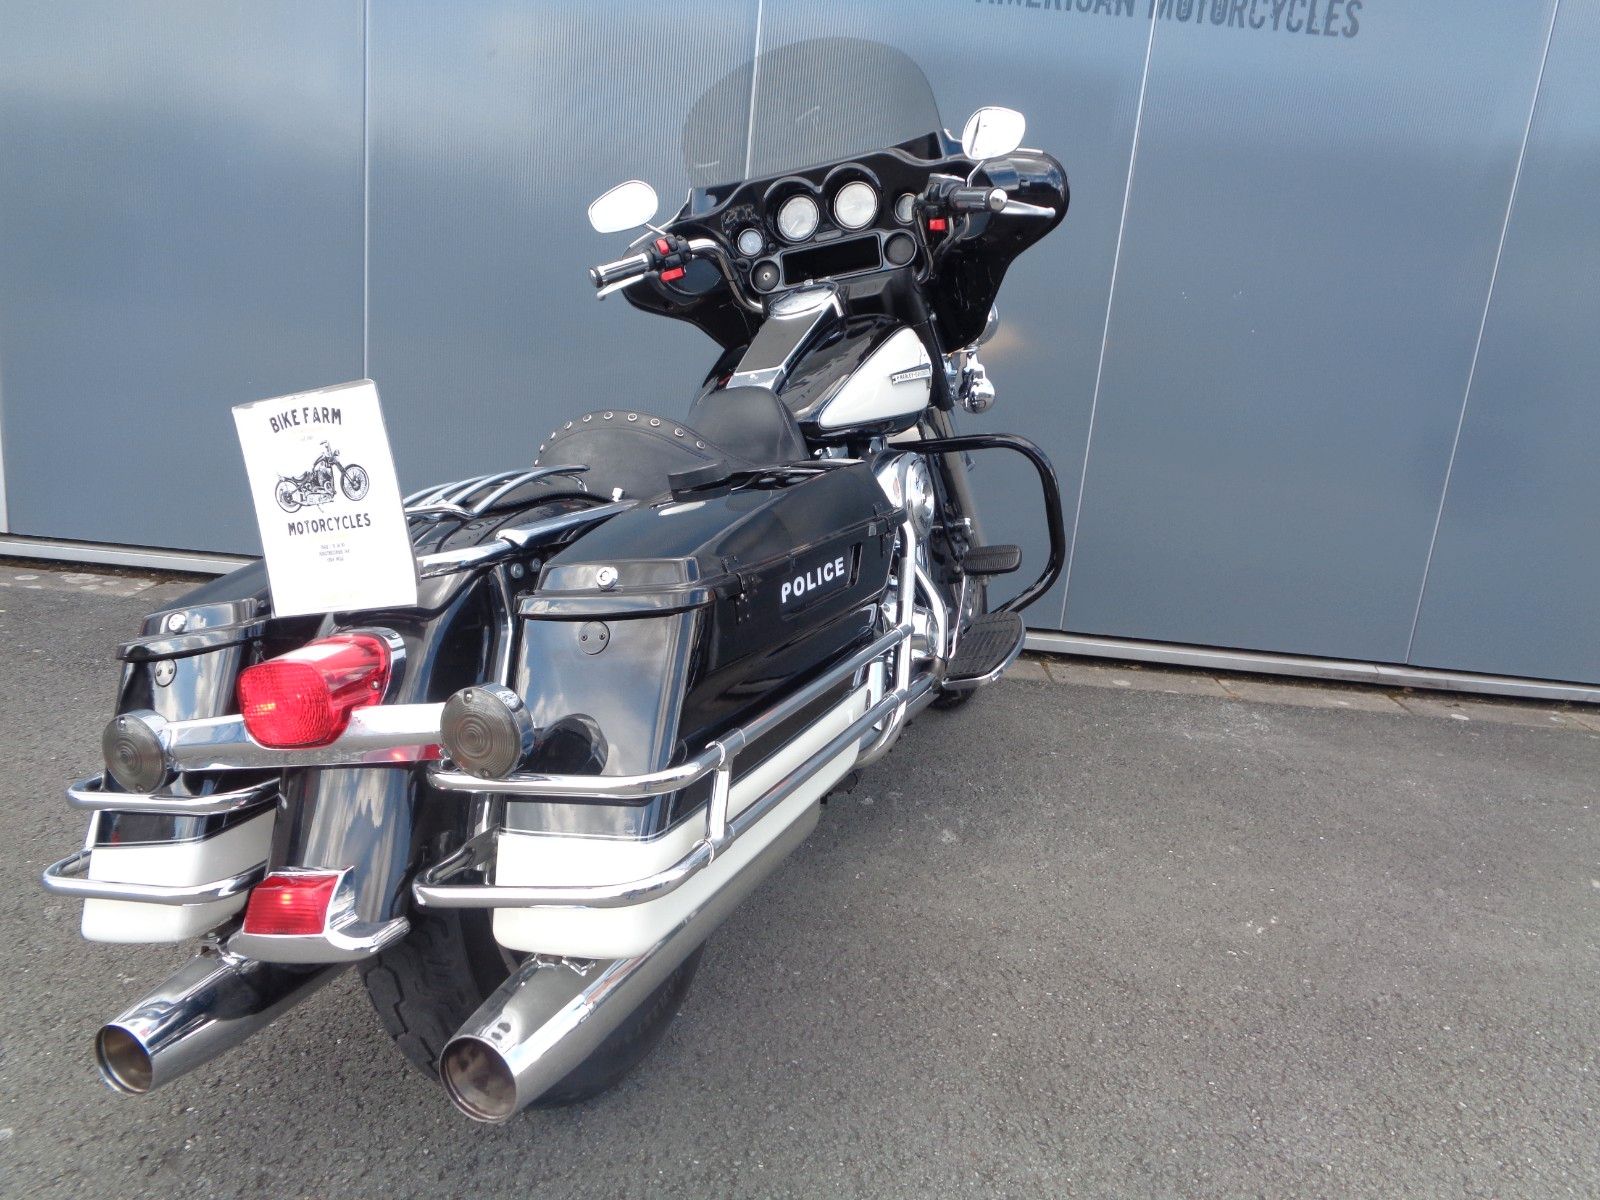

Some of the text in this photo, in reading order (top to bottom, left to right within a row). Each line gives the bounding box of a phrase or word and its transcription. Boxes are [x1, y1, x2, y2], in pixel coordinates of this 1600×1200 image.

[269, 406, 342, 433] BIKE FARM
[287, 513, 371, 536] MOTORCYCLES
[781, 556, 845, 604] POLICE
